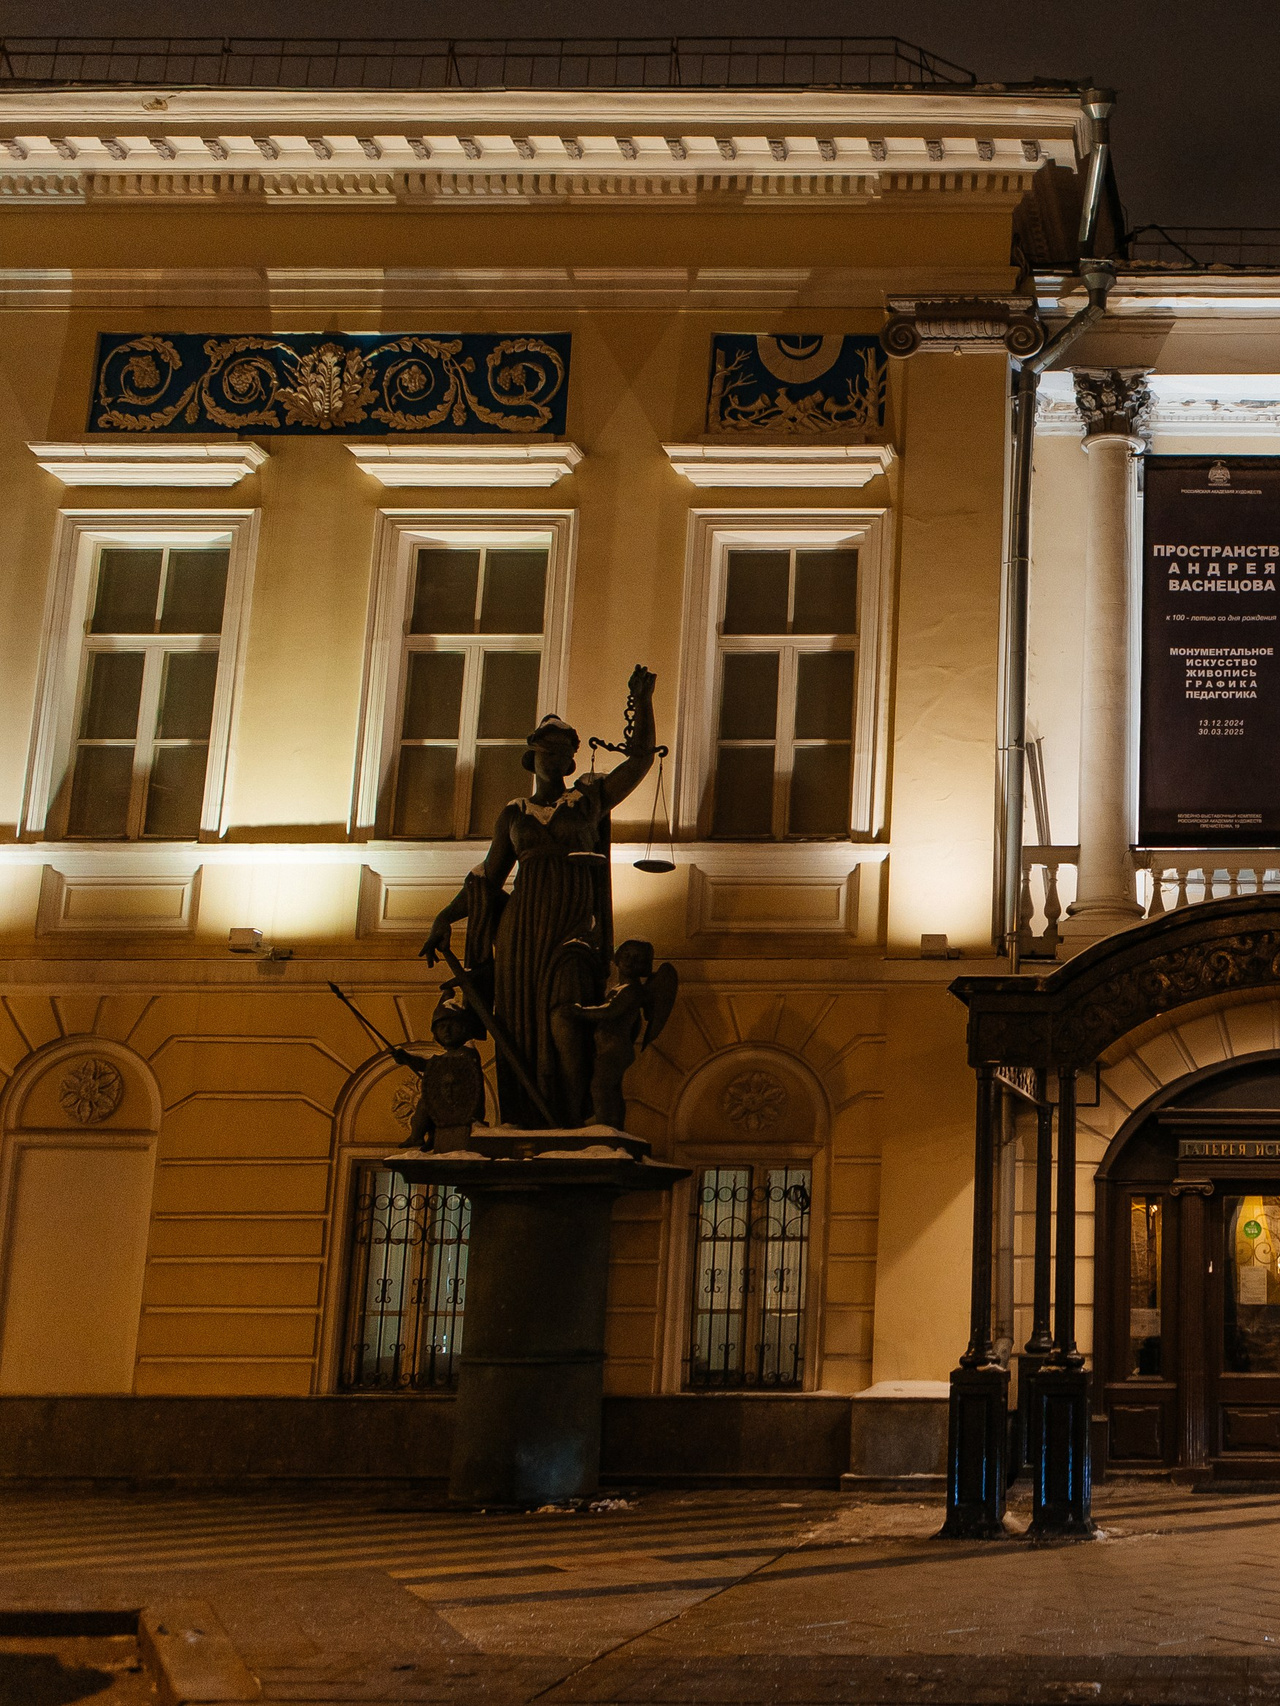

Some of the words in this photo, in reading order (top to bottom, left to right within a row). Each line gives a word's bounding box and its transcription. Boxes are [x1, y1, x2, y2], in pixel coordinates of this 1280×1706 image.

[1168, 562, 1276, 577] АНДРЕЯ
[1168, 579, 1276, 594] ВАСНЕЦОВА
[1227, 614, 1240, 622] дня
[1242, 614, 1277, 622] рождения
[1170, 648, 1274, 656] МОНУМЕНТАЛЬНОЕ
[1186, 659, 1257, 667] ИСКУССТВО
[1186, 669, 1257, 678] ЖИВОПИСЬ
[1185, 680, 1258, 688] ГРАФИКА
[1186, 690, 1257, 700] ПЕДАГОГИКА
[1184, 1144, 1246, 1156] ГАЛЕРЕЯ
